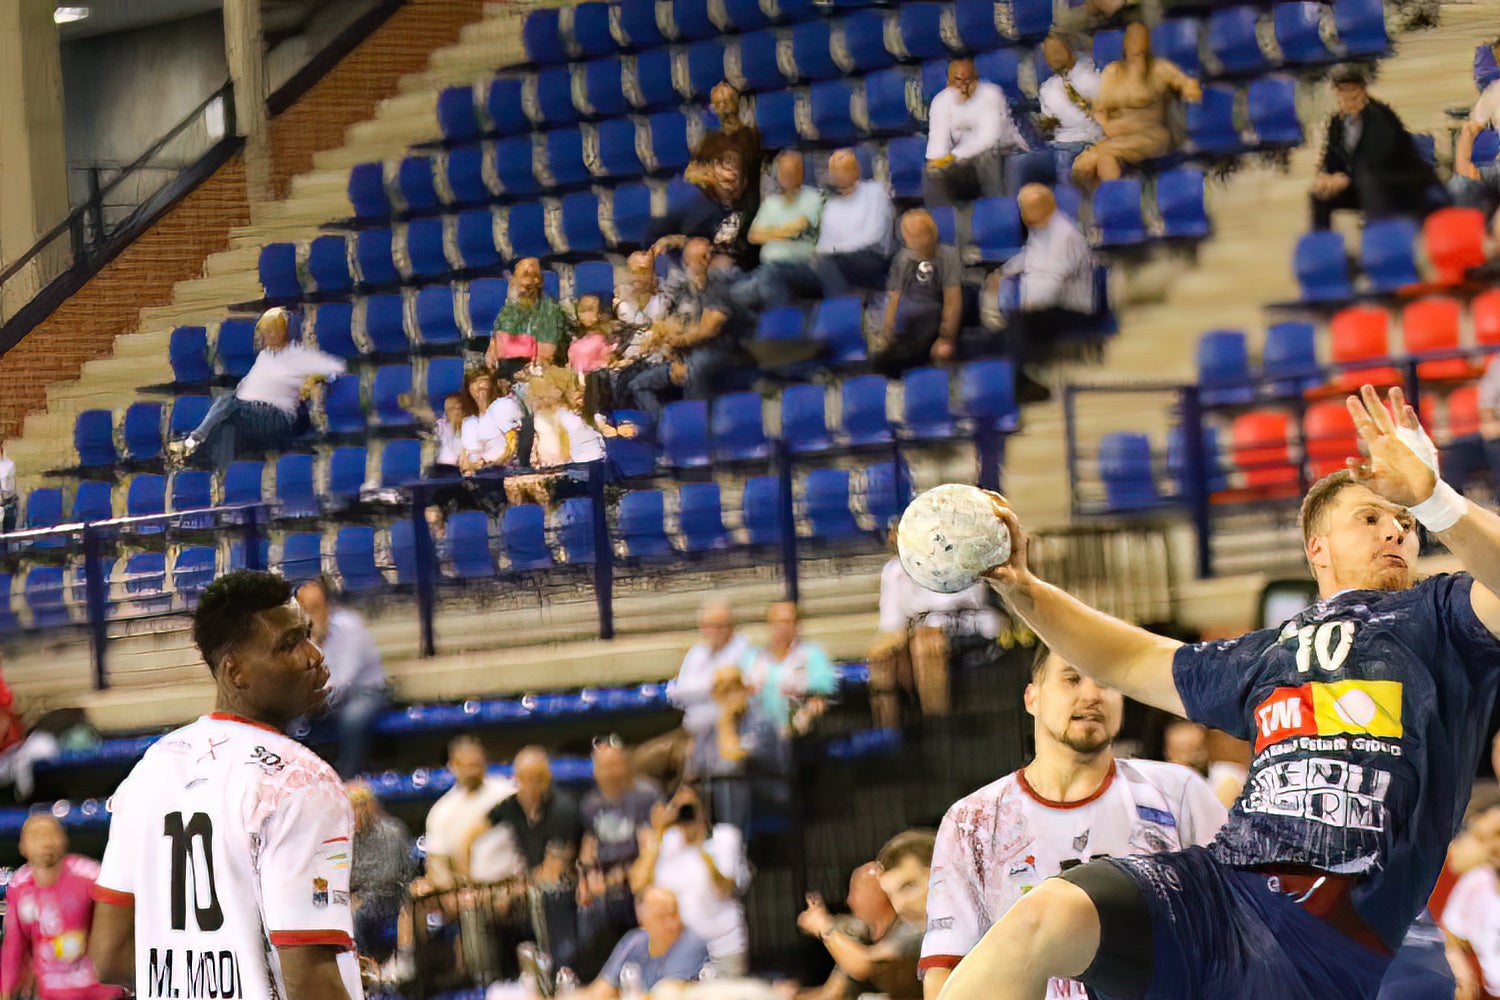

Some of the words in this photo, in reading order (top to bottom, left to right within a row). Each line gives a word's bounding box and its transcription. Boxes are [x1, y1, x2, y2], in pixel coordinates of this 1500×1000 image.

[1282, 620, 1356, 673] 10
[1258, 697, 1302, 737] TM
[163, 811, 225, 932] 10
[148, 947, 180, 999] M.
